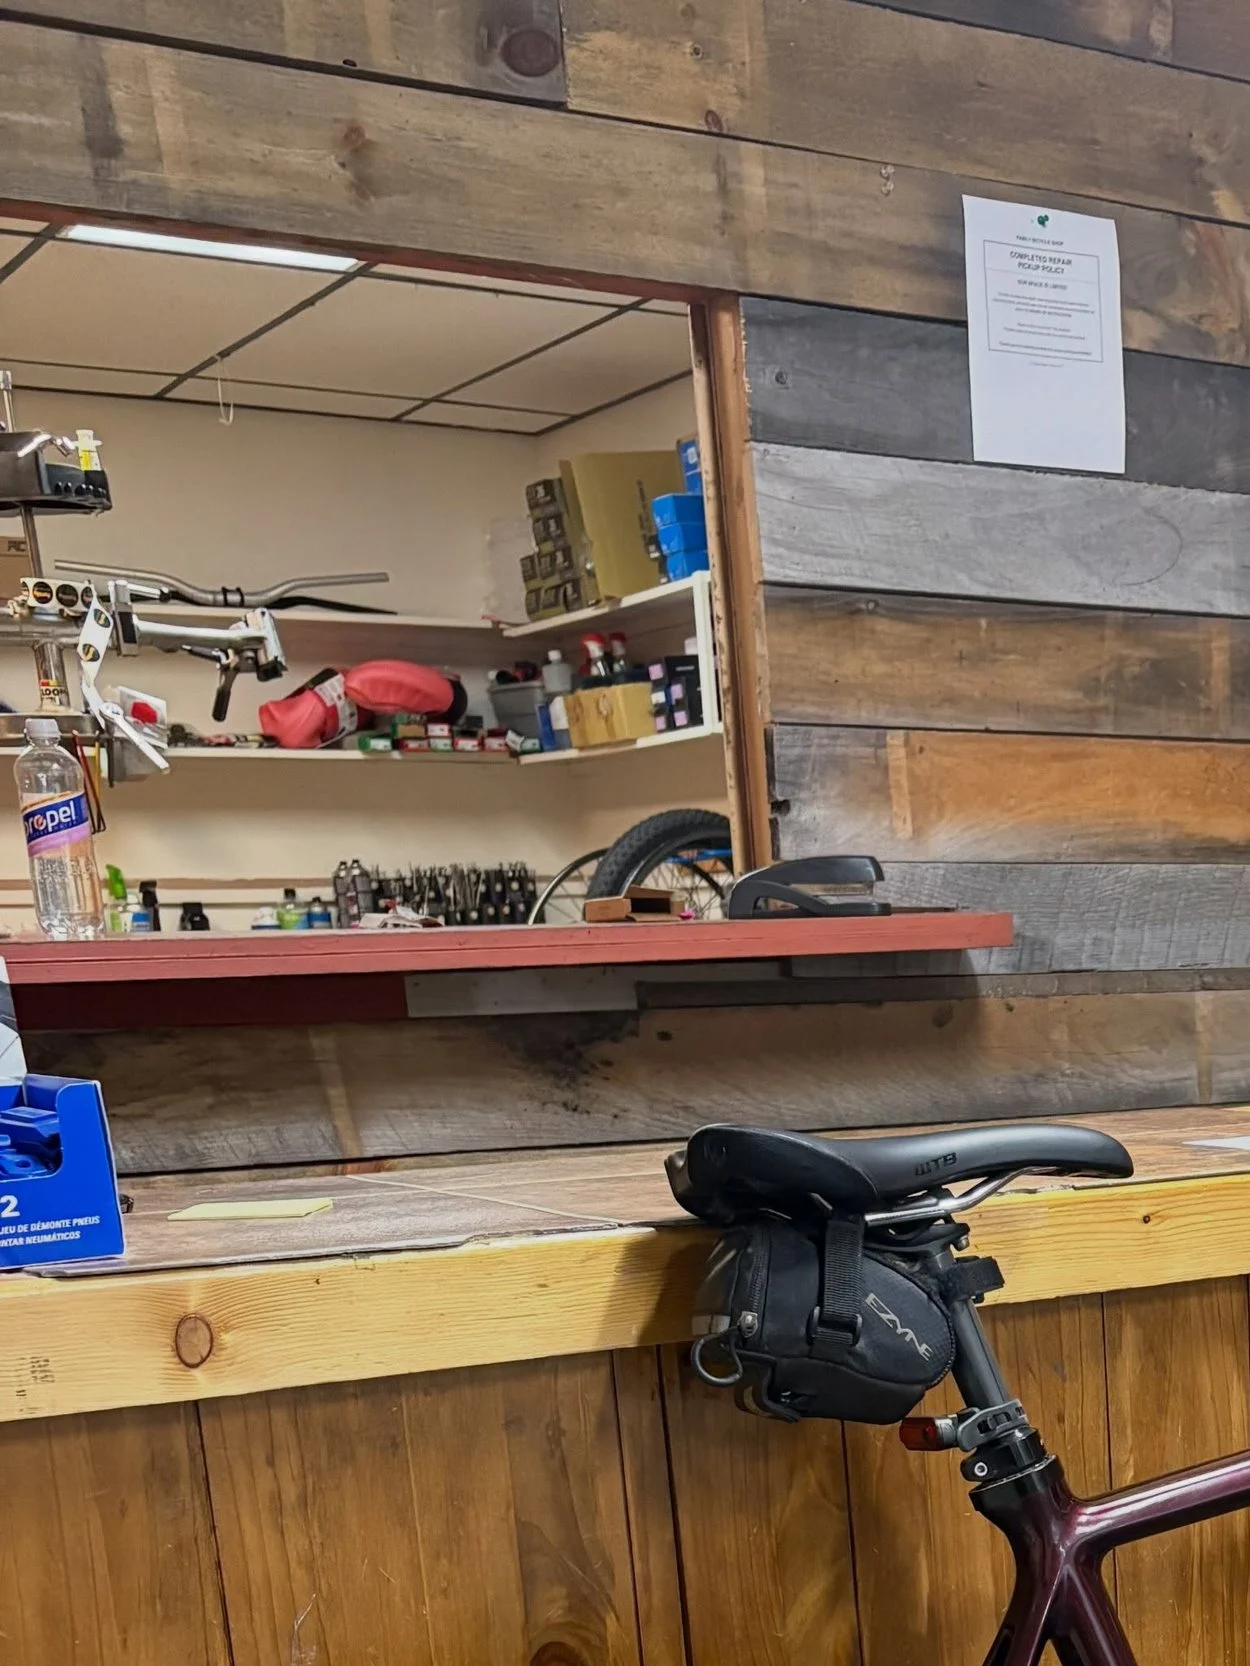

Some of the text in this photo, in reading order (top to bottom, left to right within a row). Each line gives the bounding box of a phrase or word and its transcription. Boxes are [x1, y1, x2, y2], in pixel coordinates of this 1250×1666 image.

[1010, 250, 1072, 266] COMPLETED REPAIR
[1018, 261, 1065, 275] PICKUP POLICY
[914, 1152, 957, 1177] WTB
[17, 1223, 29, 1233] DE
[30, 1219, 71, 1232] DÉMONTE
[72, 1215, 100, 1227] PNEUS
[25, 1230, 81, 1244] NEUMÁTICOS
[865, 1292, 933, 1361] EZYNE
